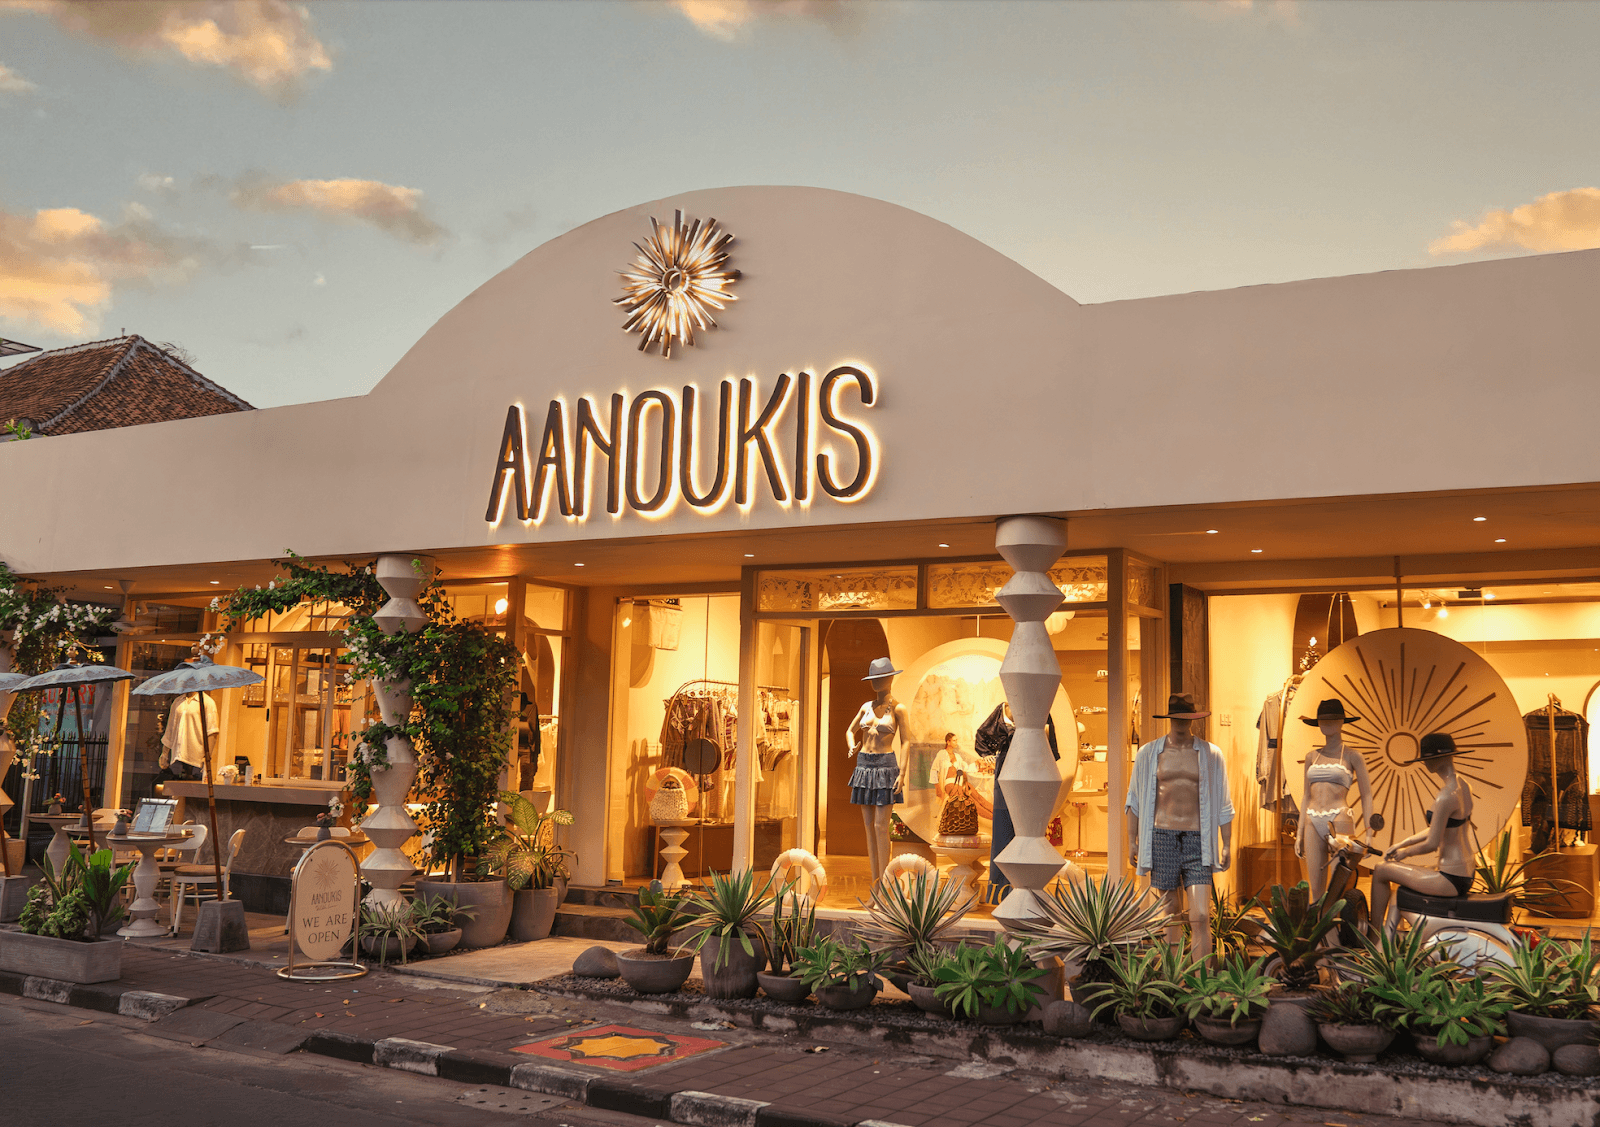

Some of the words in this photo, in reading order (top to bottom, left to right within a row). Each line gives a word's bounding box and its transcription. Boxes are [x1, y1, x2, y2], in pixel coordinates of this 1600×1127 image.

[485, 366, 873, 522] AANOUKIS
[311, 890, 342, 905] AANOUKIS
[302, 917, 320, 928] WE
[325, 913, 348, 926] ARE
[308, 930, 340, 944] OPEN
